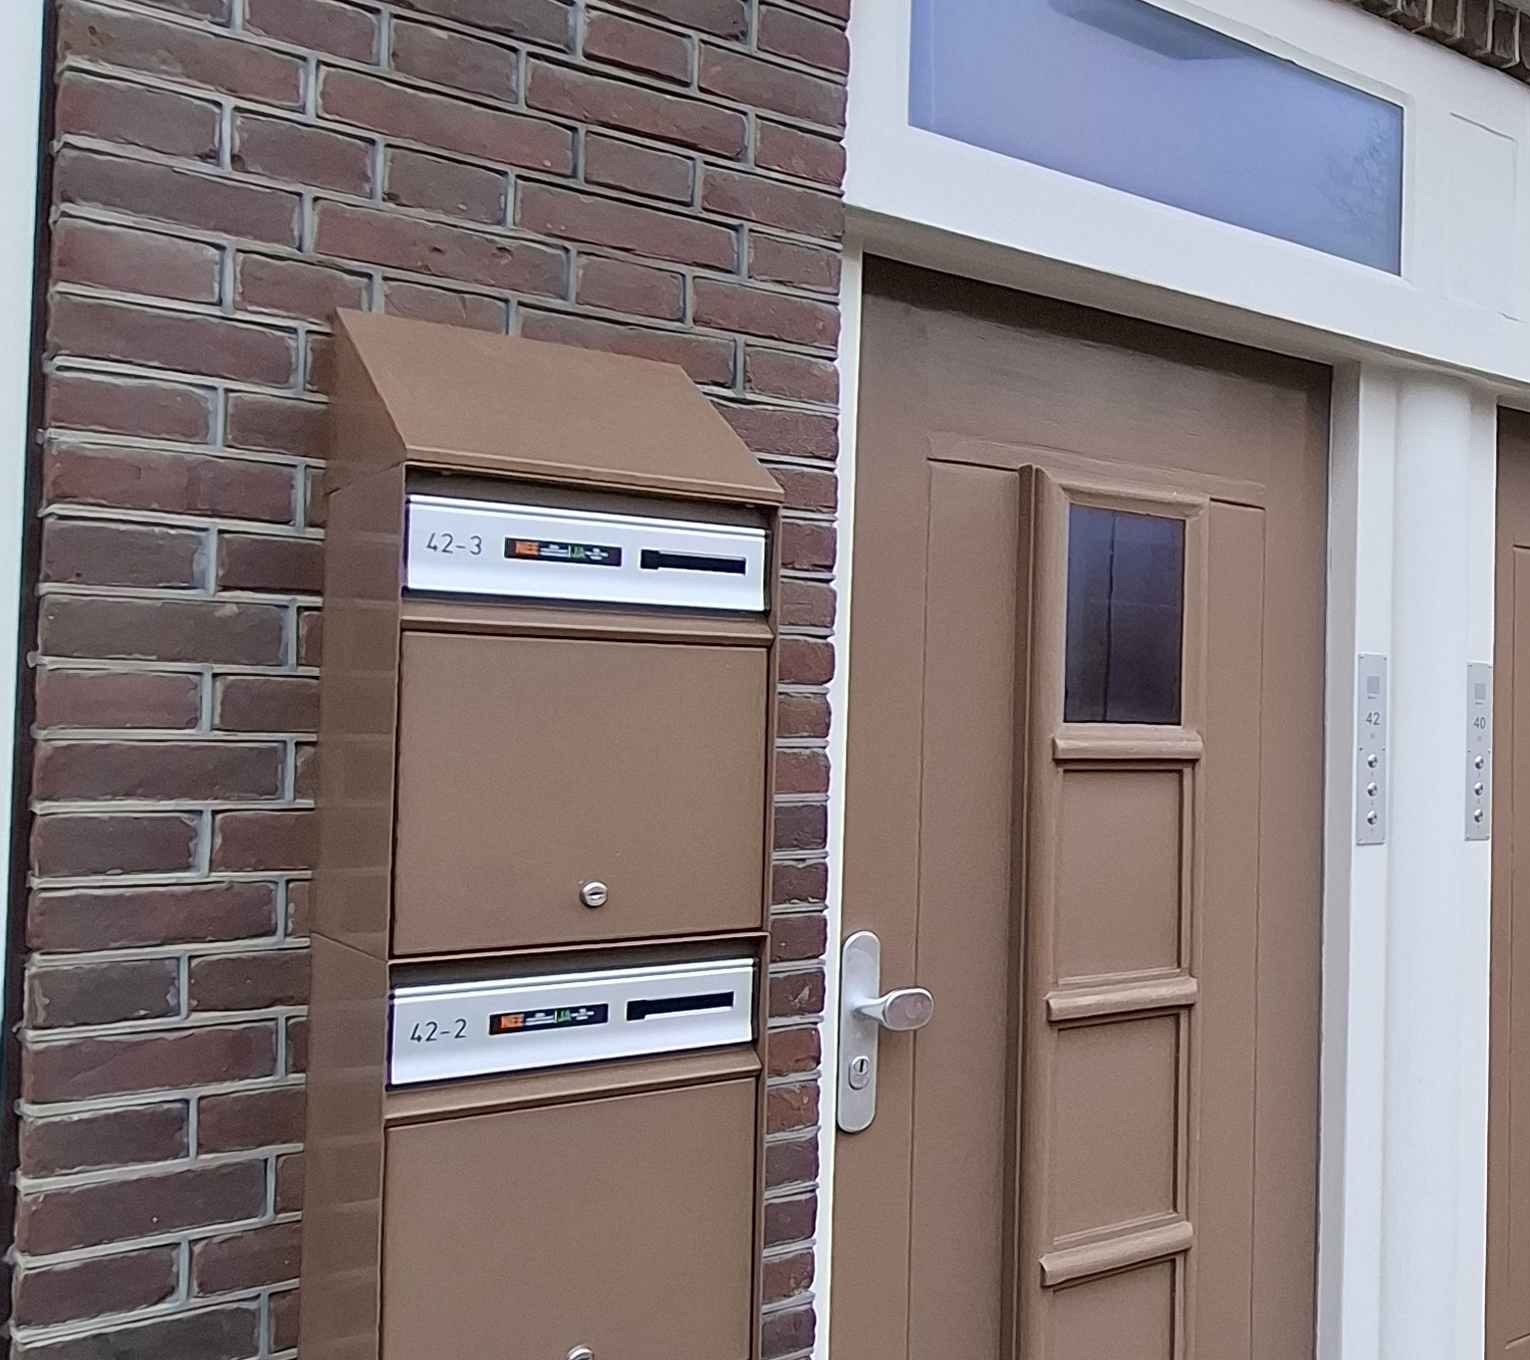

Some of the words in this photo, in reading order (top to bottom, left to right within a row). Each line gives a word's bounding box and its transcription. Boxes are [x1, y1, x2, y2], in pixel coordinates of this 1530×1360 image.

[426, 532, 483, 556] 42-3
[1365, 711, 1381, 727] 42
[1473, 716, 1486, 730] 40
[409, 1018, 468, 1043] 42-2
